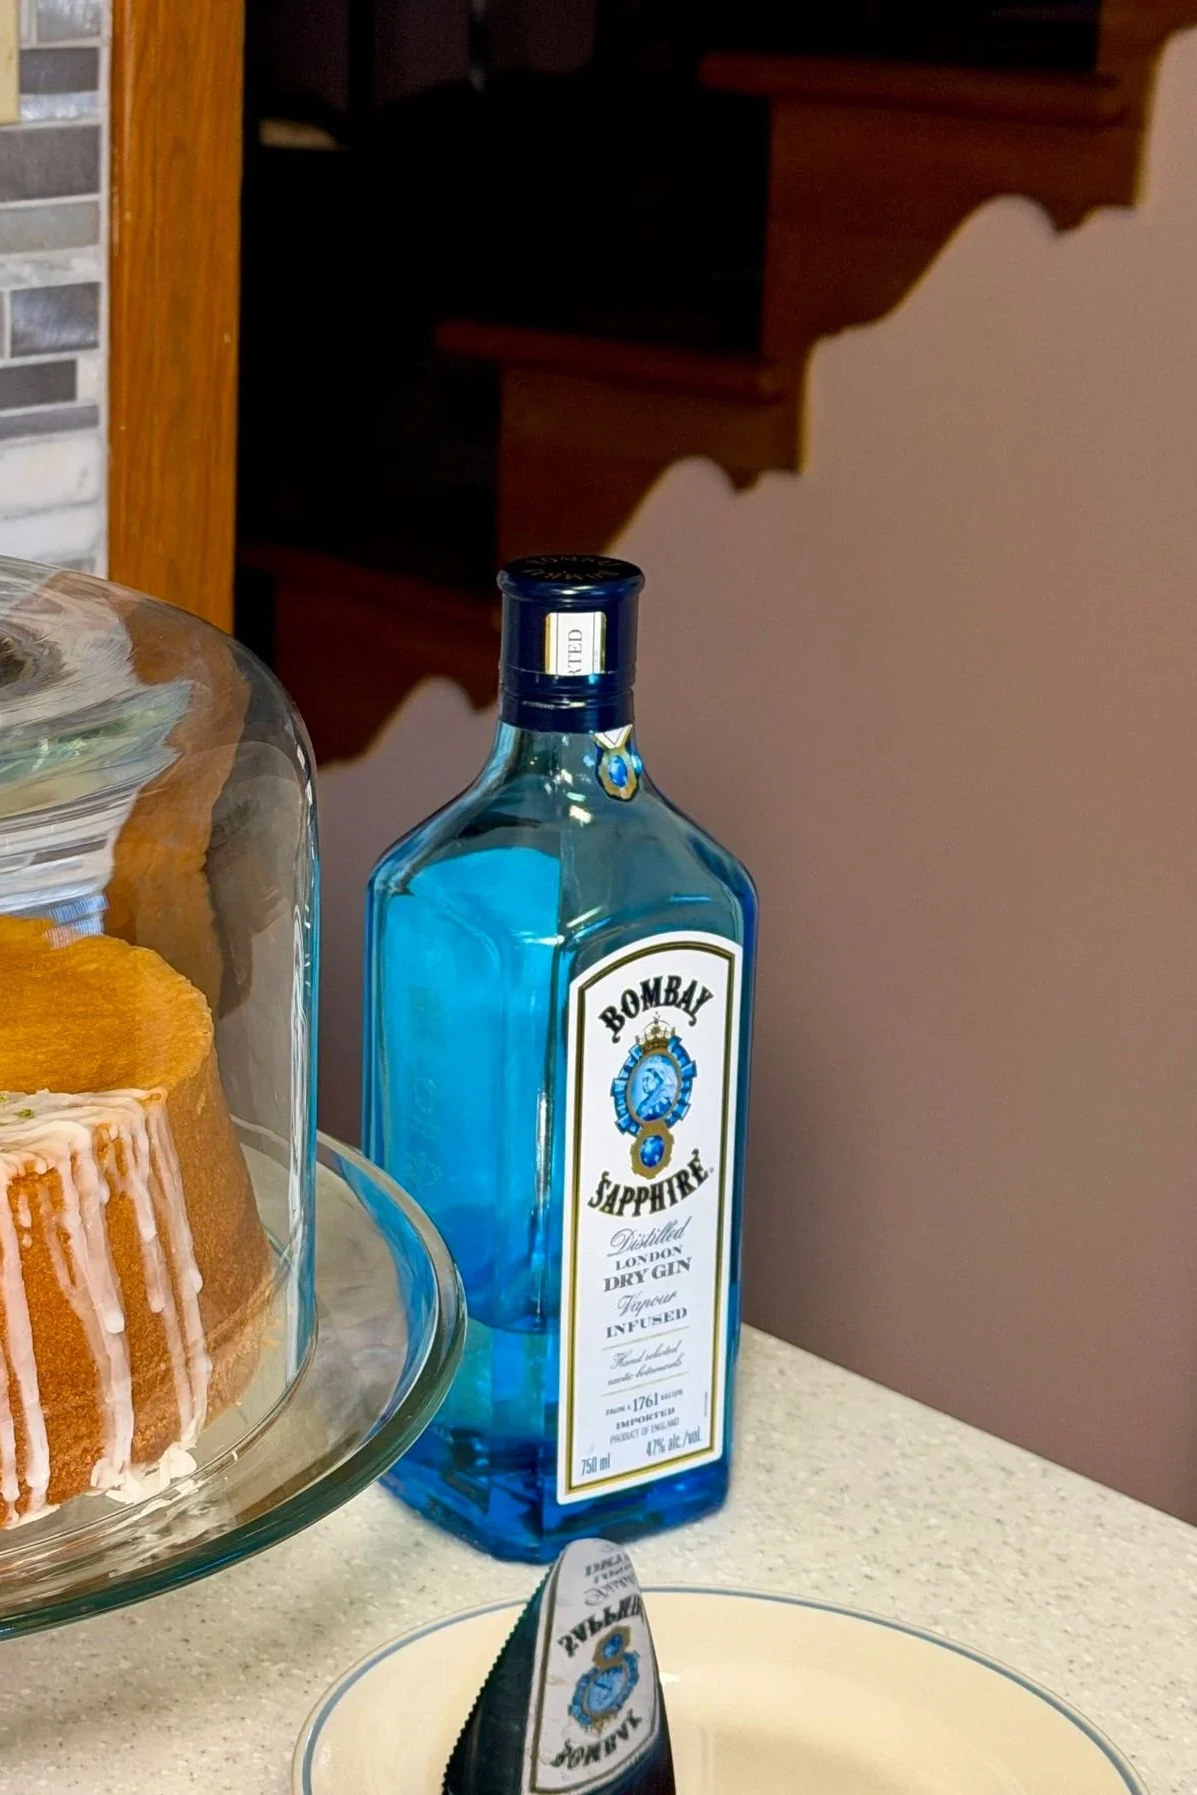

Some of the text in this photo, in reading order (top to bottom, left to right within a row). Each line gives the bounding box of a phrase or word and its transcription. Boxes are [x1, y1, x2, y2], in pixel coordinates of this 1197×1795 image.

[598, 975, 714, 1043] BOMBAY
[587, 1148, 709, 1217] SAPPHIRE
[607, 1216, 692, 1257] Distilled
[615, 1244, 683, 1271] LONDON
[603, 1257, 692, 1293] DRY GIN
[617, 1290, 678, 1317] Vapour
[606, 1307, 688, 1339] INFUSED
[633, 1392, 659, 1412] 1761
[609, 1417, 680, 1445] PRODUCT OF ENGLAND
[616, 1406, 676, 1430] IMPORTED
[646, 1437, 666, 1457] 47%
[581, 1452, 611, 1476] 750 ml
